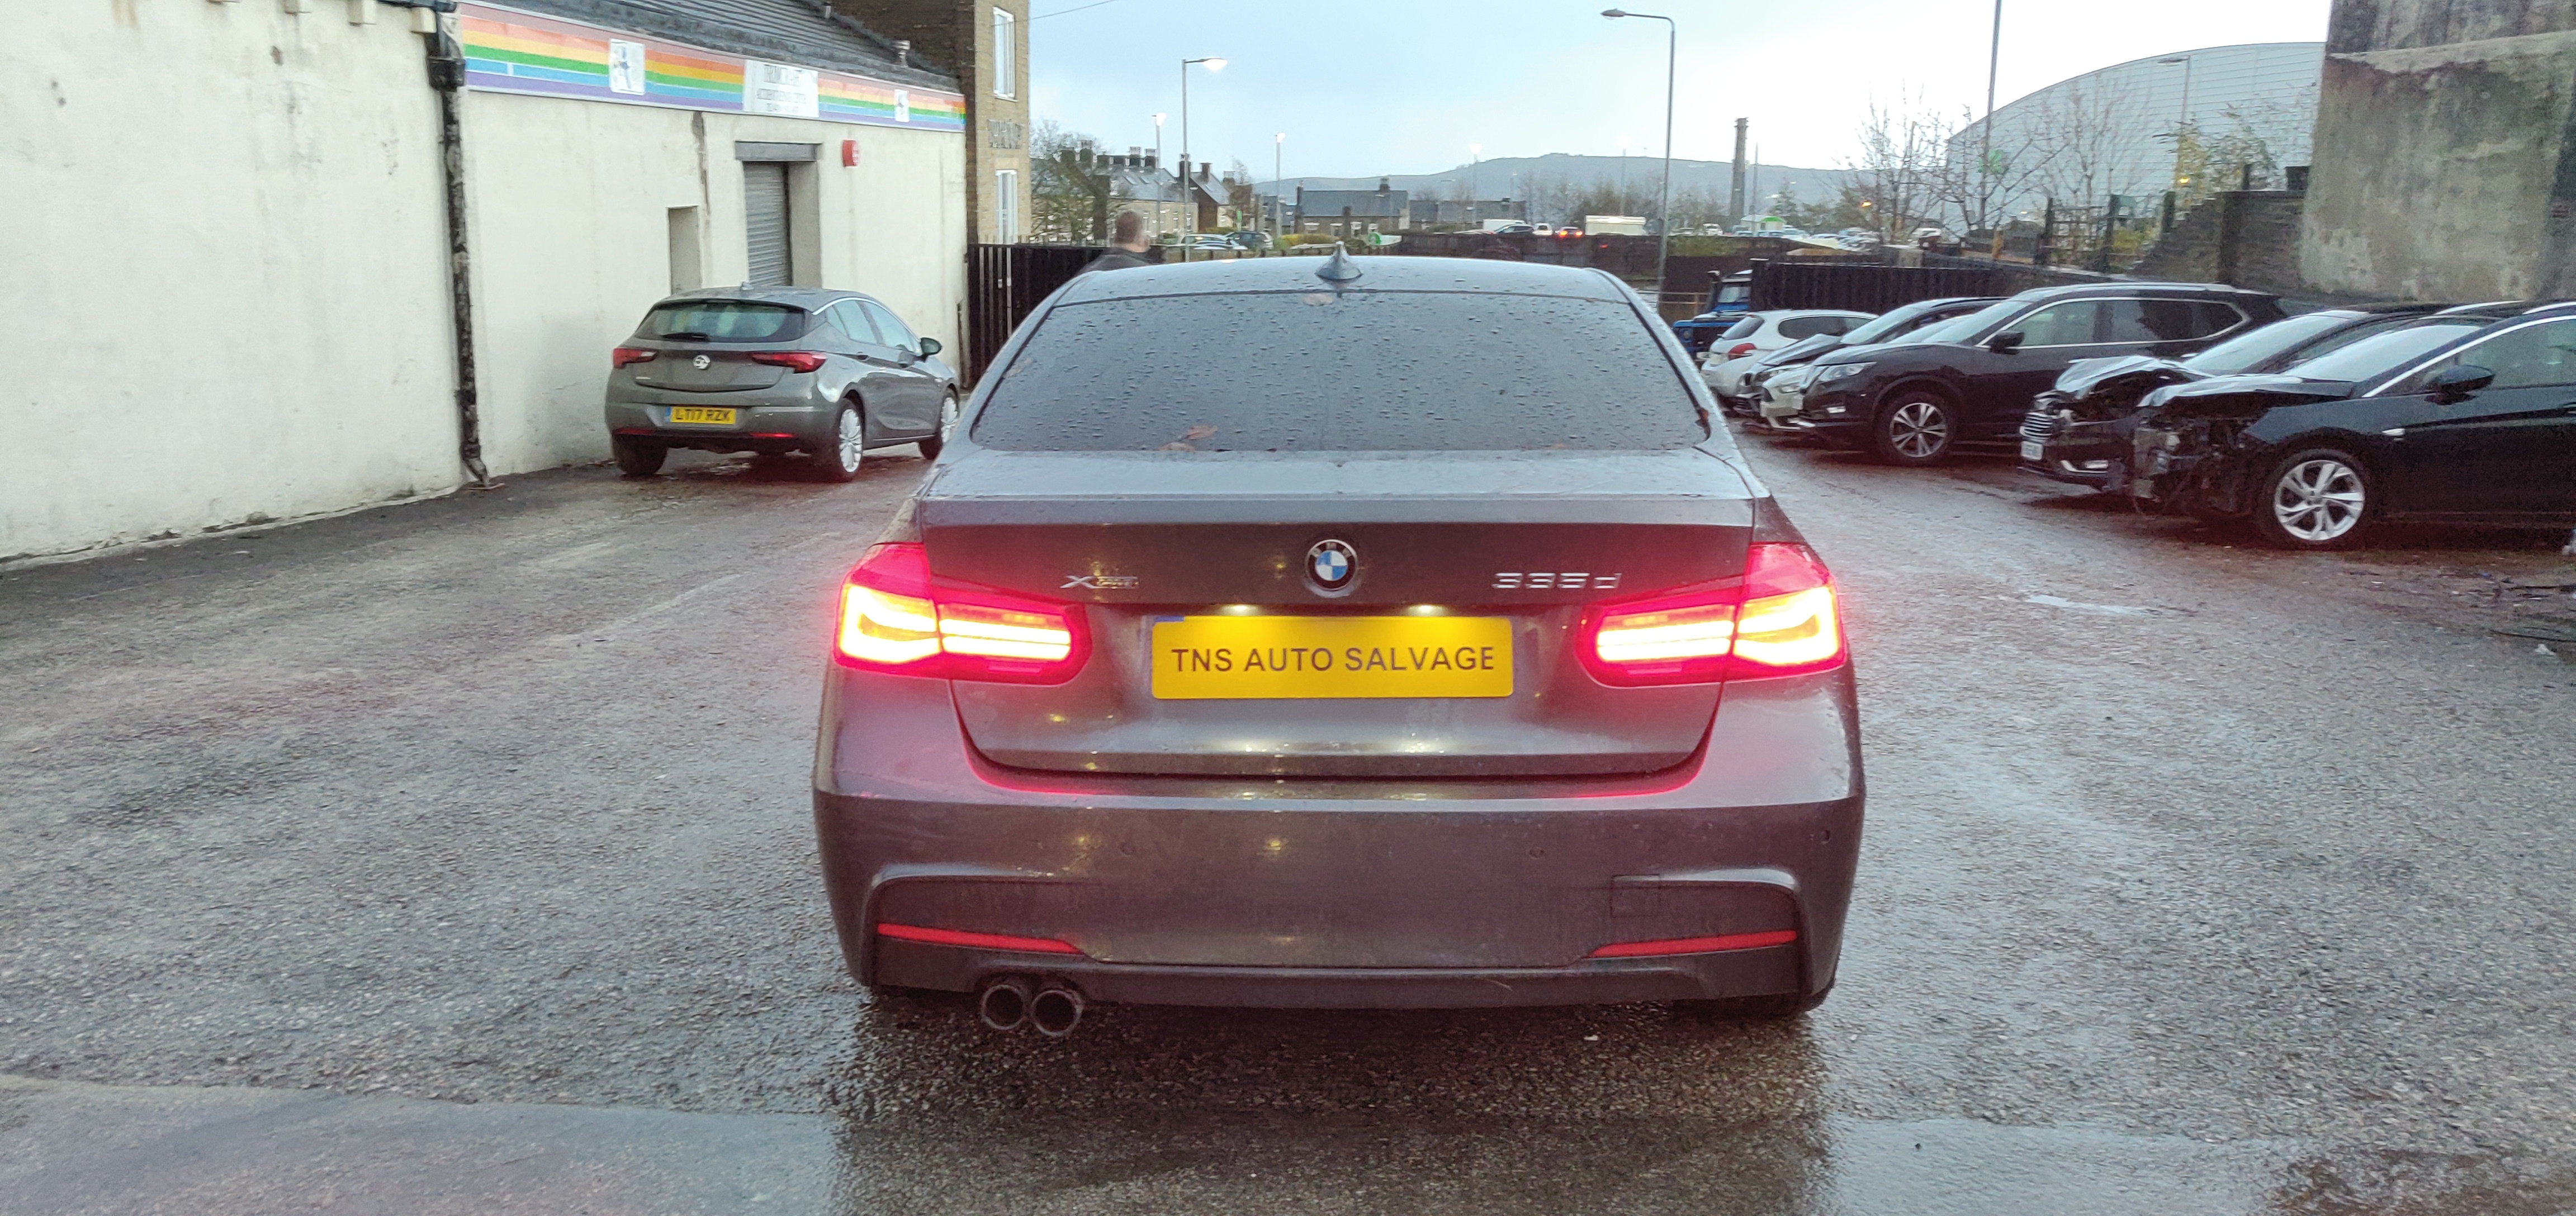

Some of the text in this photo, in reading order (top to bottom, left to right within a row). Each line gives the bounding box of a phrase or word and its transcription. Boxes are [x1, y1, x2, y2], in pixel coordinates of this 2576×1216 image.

[1171, 647, 1494, 672] TNS AUTO SALVAGE
